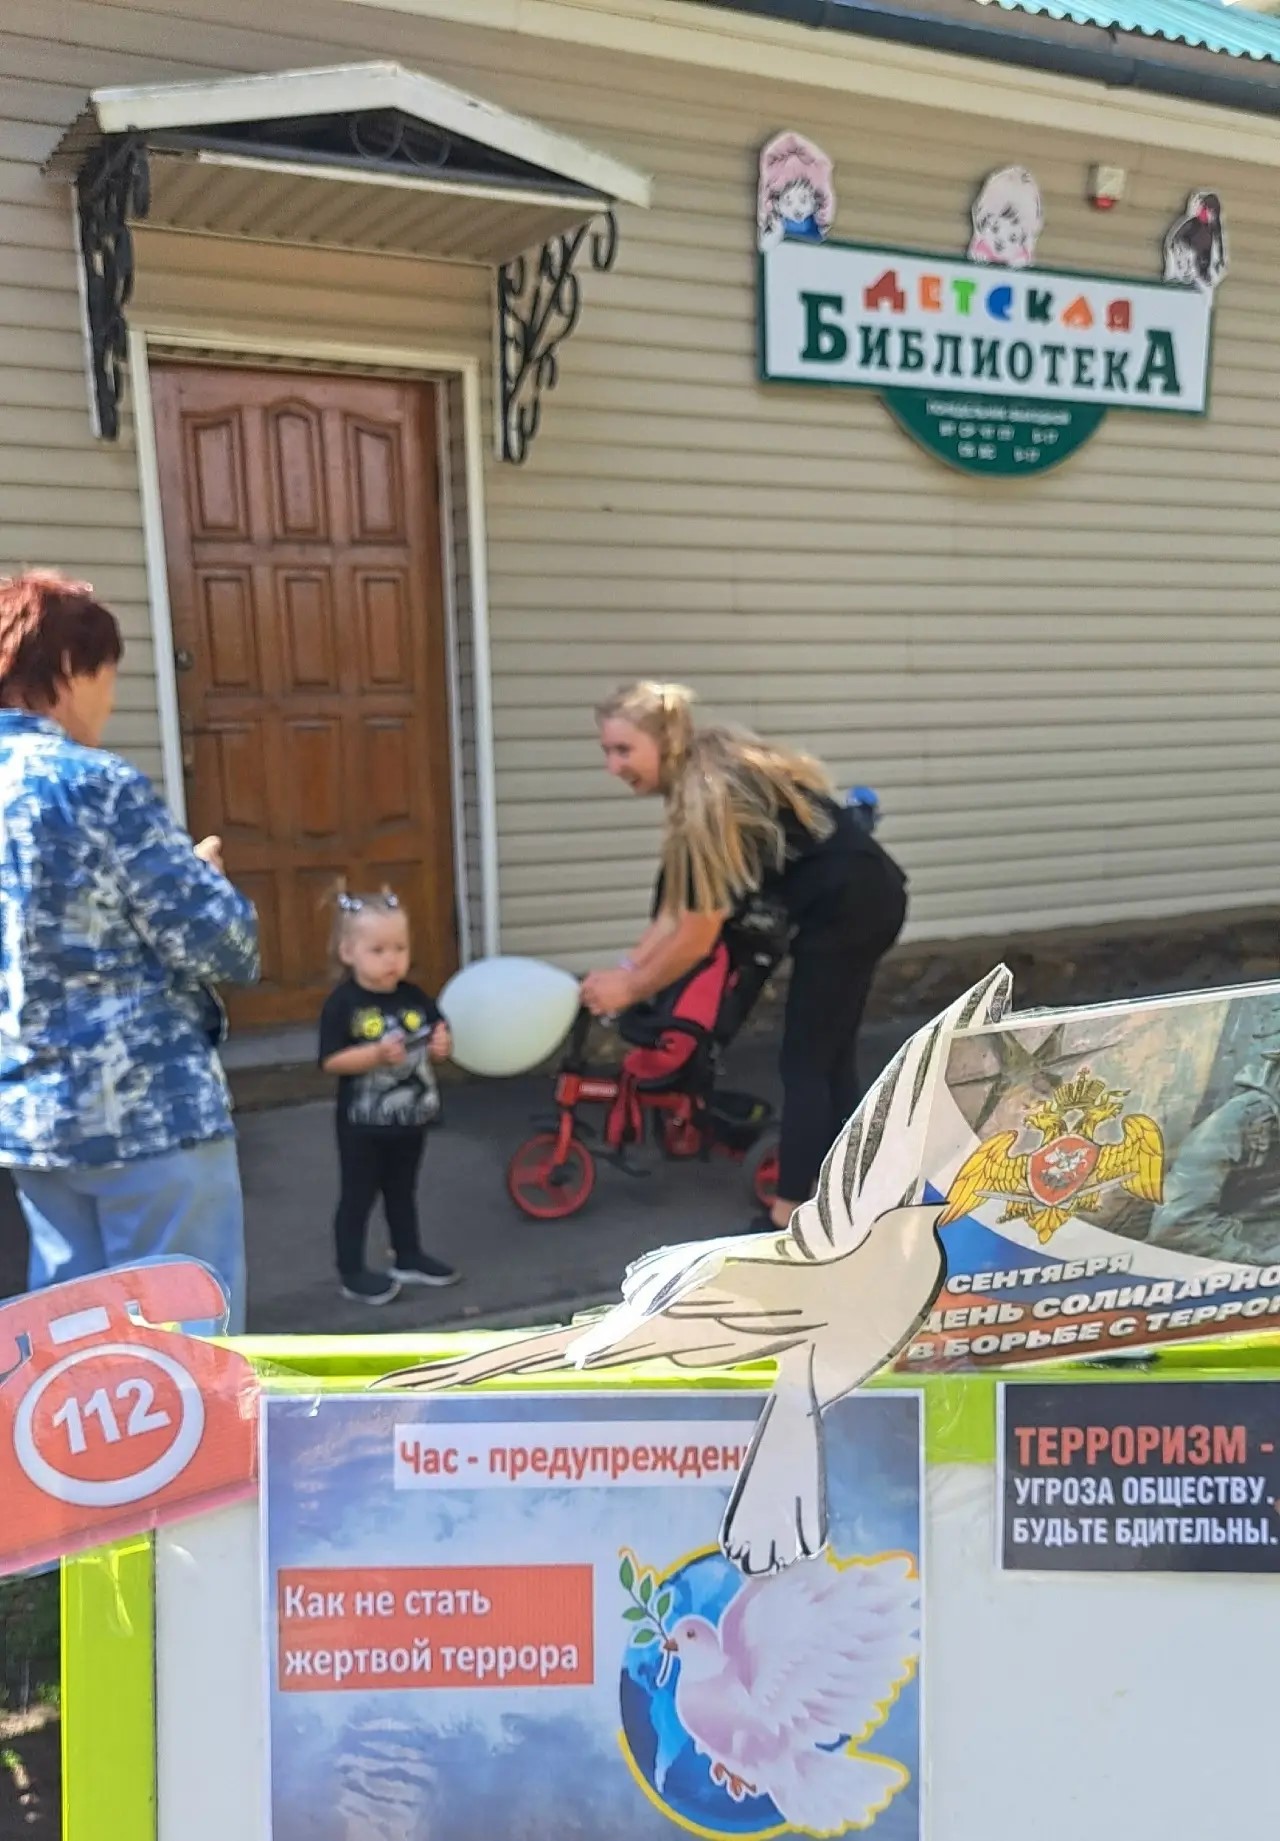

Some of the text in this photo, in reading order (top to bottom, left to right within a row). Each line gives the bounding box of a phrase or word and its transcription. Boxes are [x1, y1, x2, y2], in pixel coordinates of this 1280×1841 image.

[863, 269, 1132, 332] ДЕТСКАЯ
[799, 291, 1181, 395] БИБЛИОТЕКА
[947, 1253, 1134, 1293] СЕНТЯБРЯ
[907, 1342, 936, 1361] В
[943, 1319, 1107, 1357] БОРЬБЕ
[1108, 1317, 1137, 1337] С
[52, 1378, 172, 1455] 112
[400, 1440, 458, 1474] Час
[489, 1443, 749, 1480] предупрежден
[1014, 1425, 1247, 1466] ТЕРРОРИЗМ
[1014, 1476, 1274, 1508] УГРОЗА ОБЩЕСТВУ.
[1013, 1518, 1279, 1547] БУДЬТЕ БДИТЕЛЬНЫ.
[284, 1586, 491, 1618] Как не стать
[285, 1640, 578, 1680] жертвой террора
